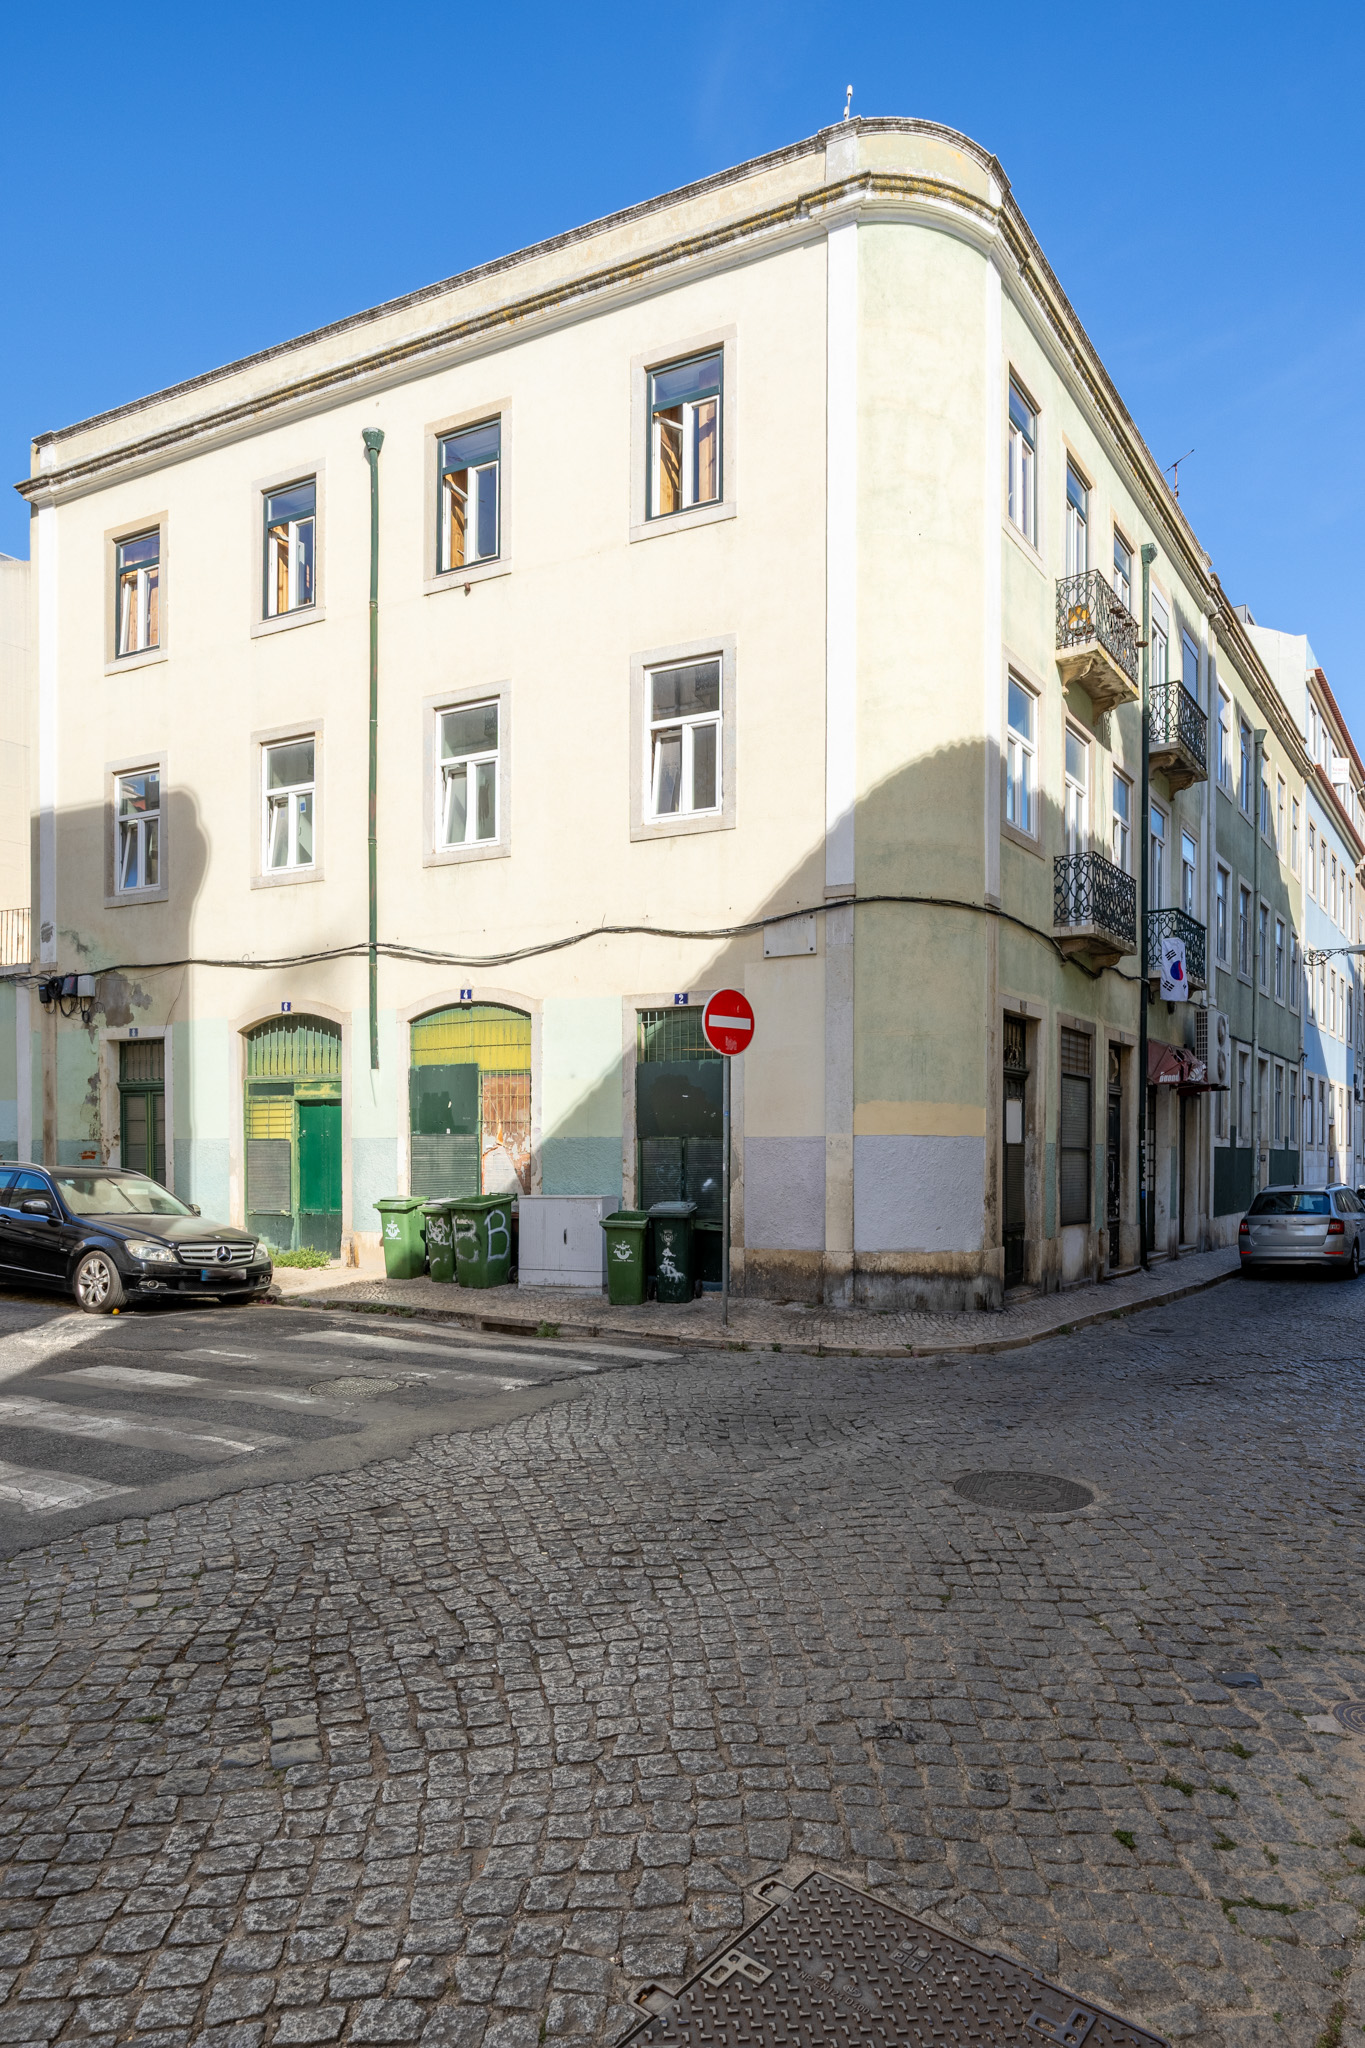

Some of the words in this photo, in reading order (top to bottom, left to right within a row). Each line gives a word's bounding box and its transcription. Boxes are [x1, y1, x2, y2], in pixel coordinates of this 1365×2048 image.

[678, 993, 684, 1004] 2
[798, 1971, 814, 1982] NP
[844, 1997, 871, 2015] D400
